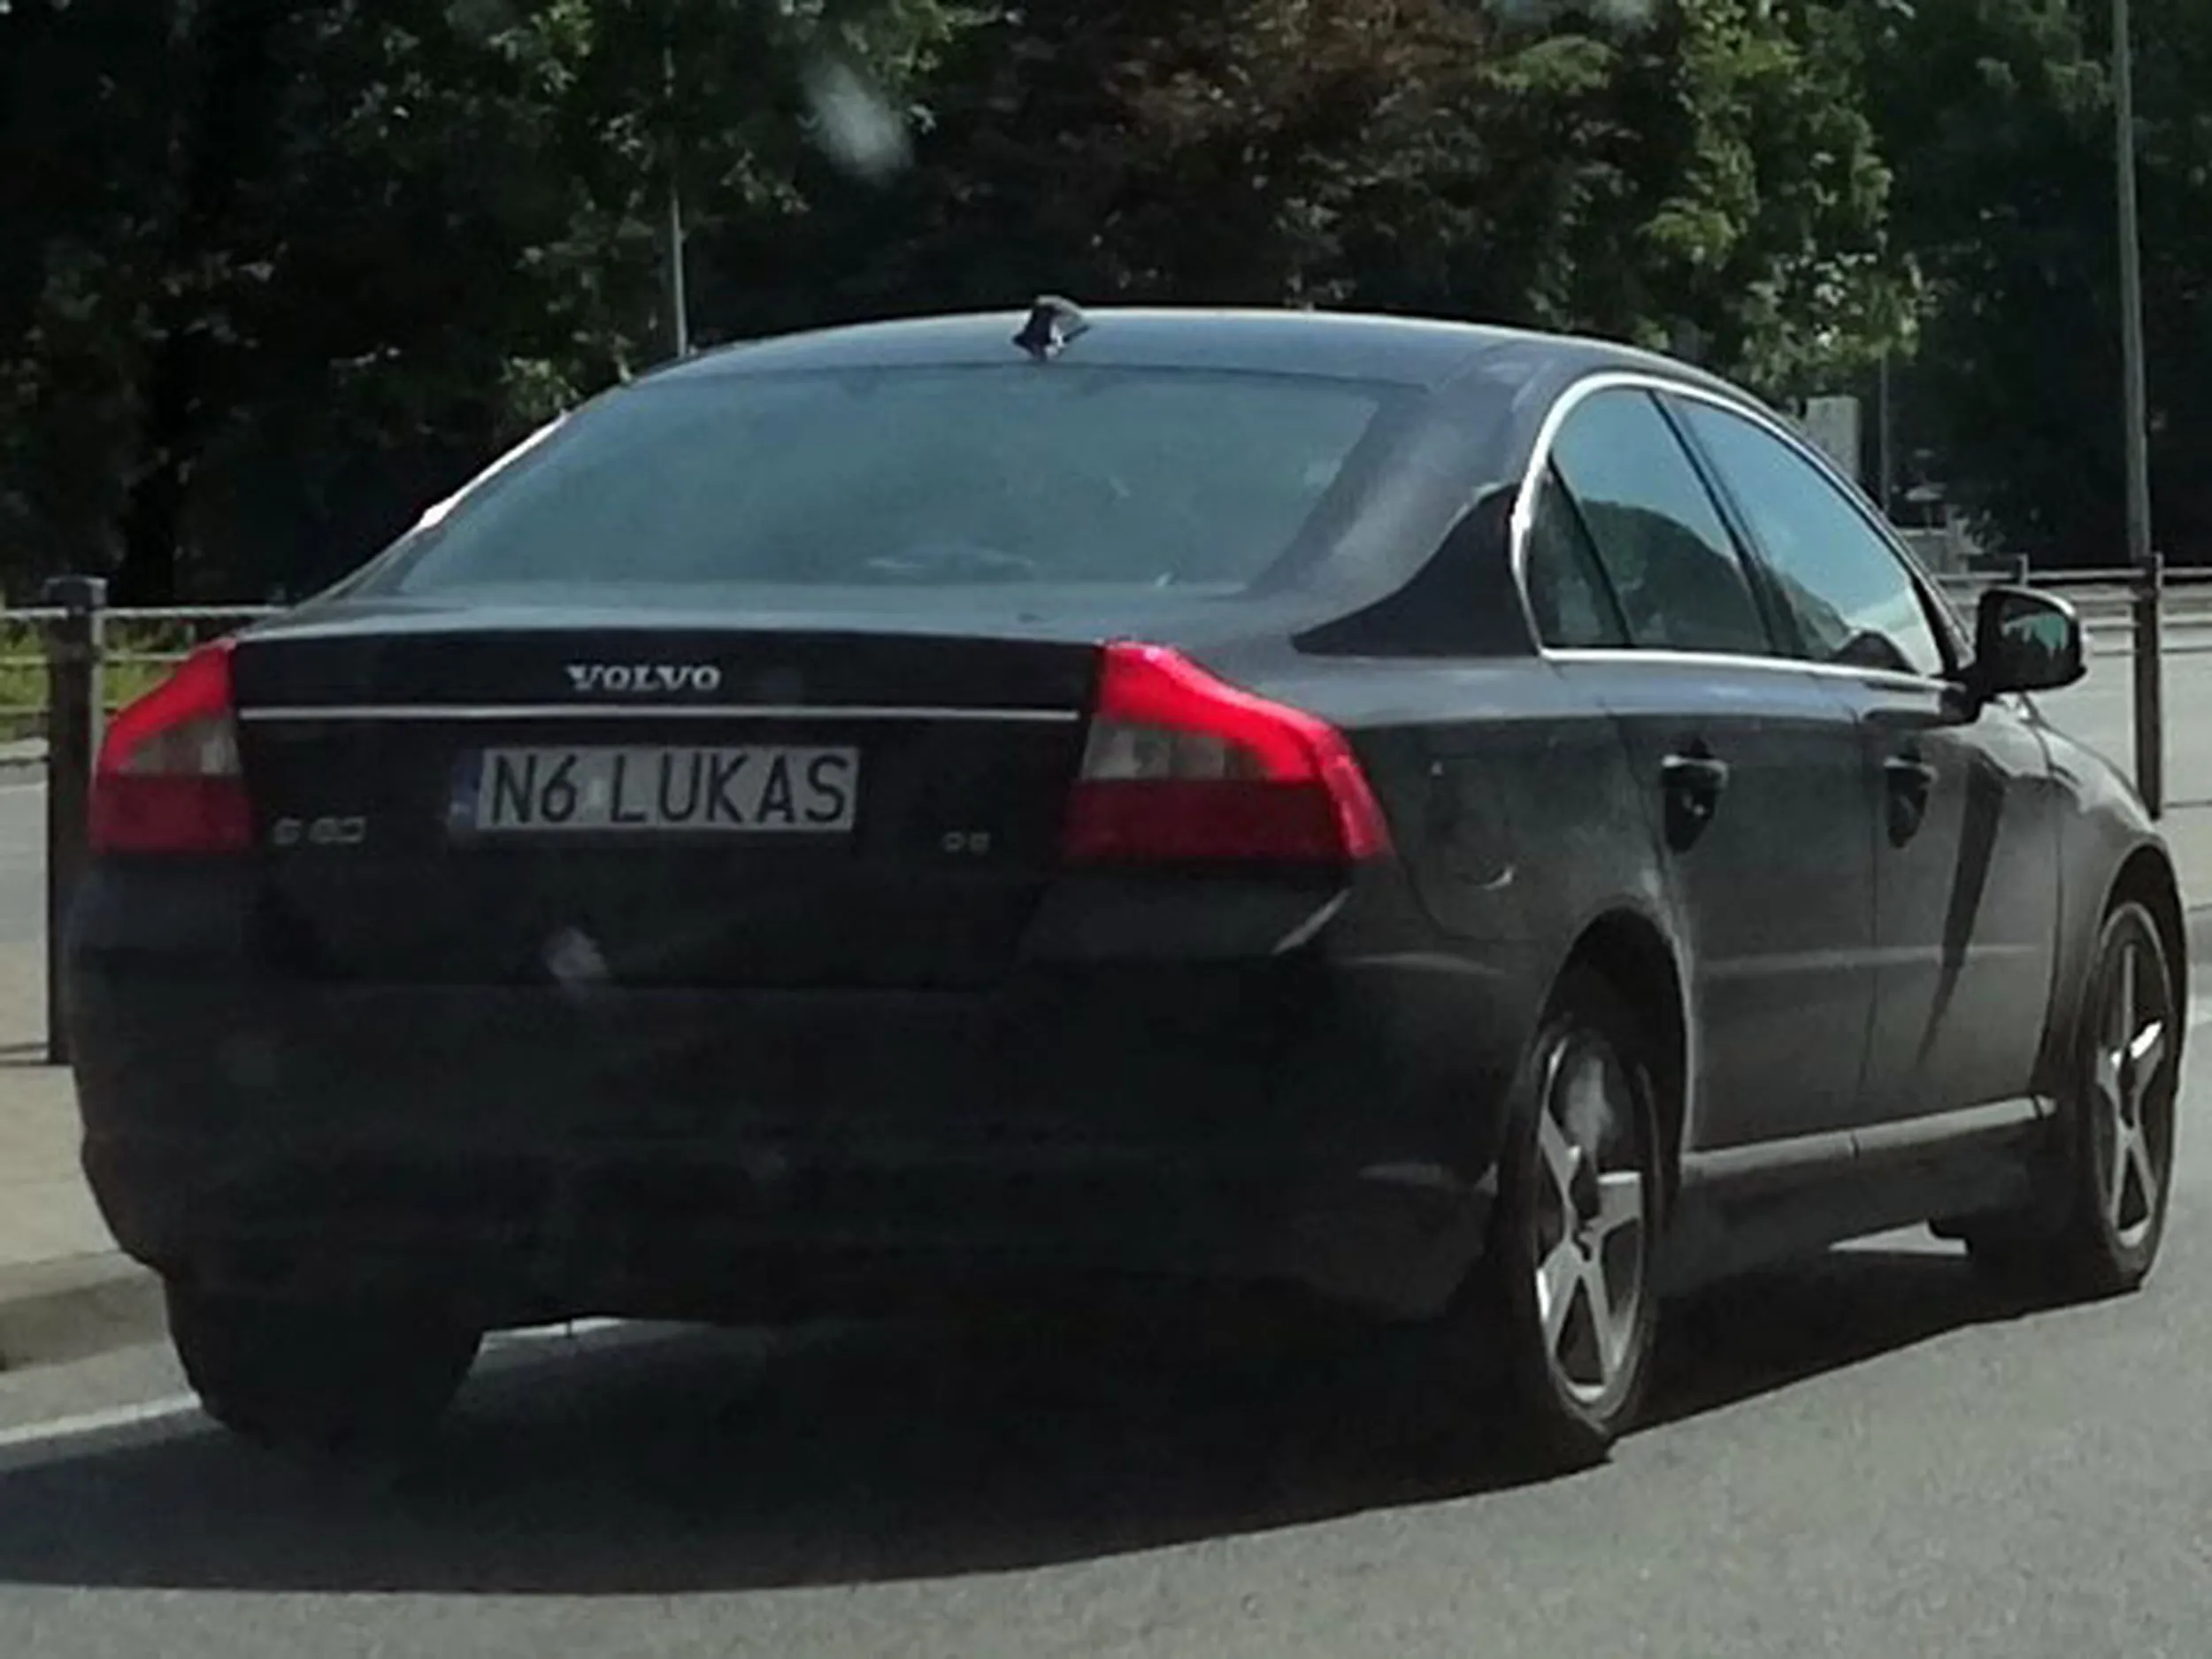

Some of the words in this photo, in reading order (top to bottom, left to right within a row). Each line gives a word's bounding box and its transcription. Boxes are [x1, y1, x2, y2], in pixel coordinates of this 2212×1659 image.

[565, 664, 723, 693] VOLVO
[489, 752, 579, 825] N6
[609, 753, 849, 825] LUKAS
